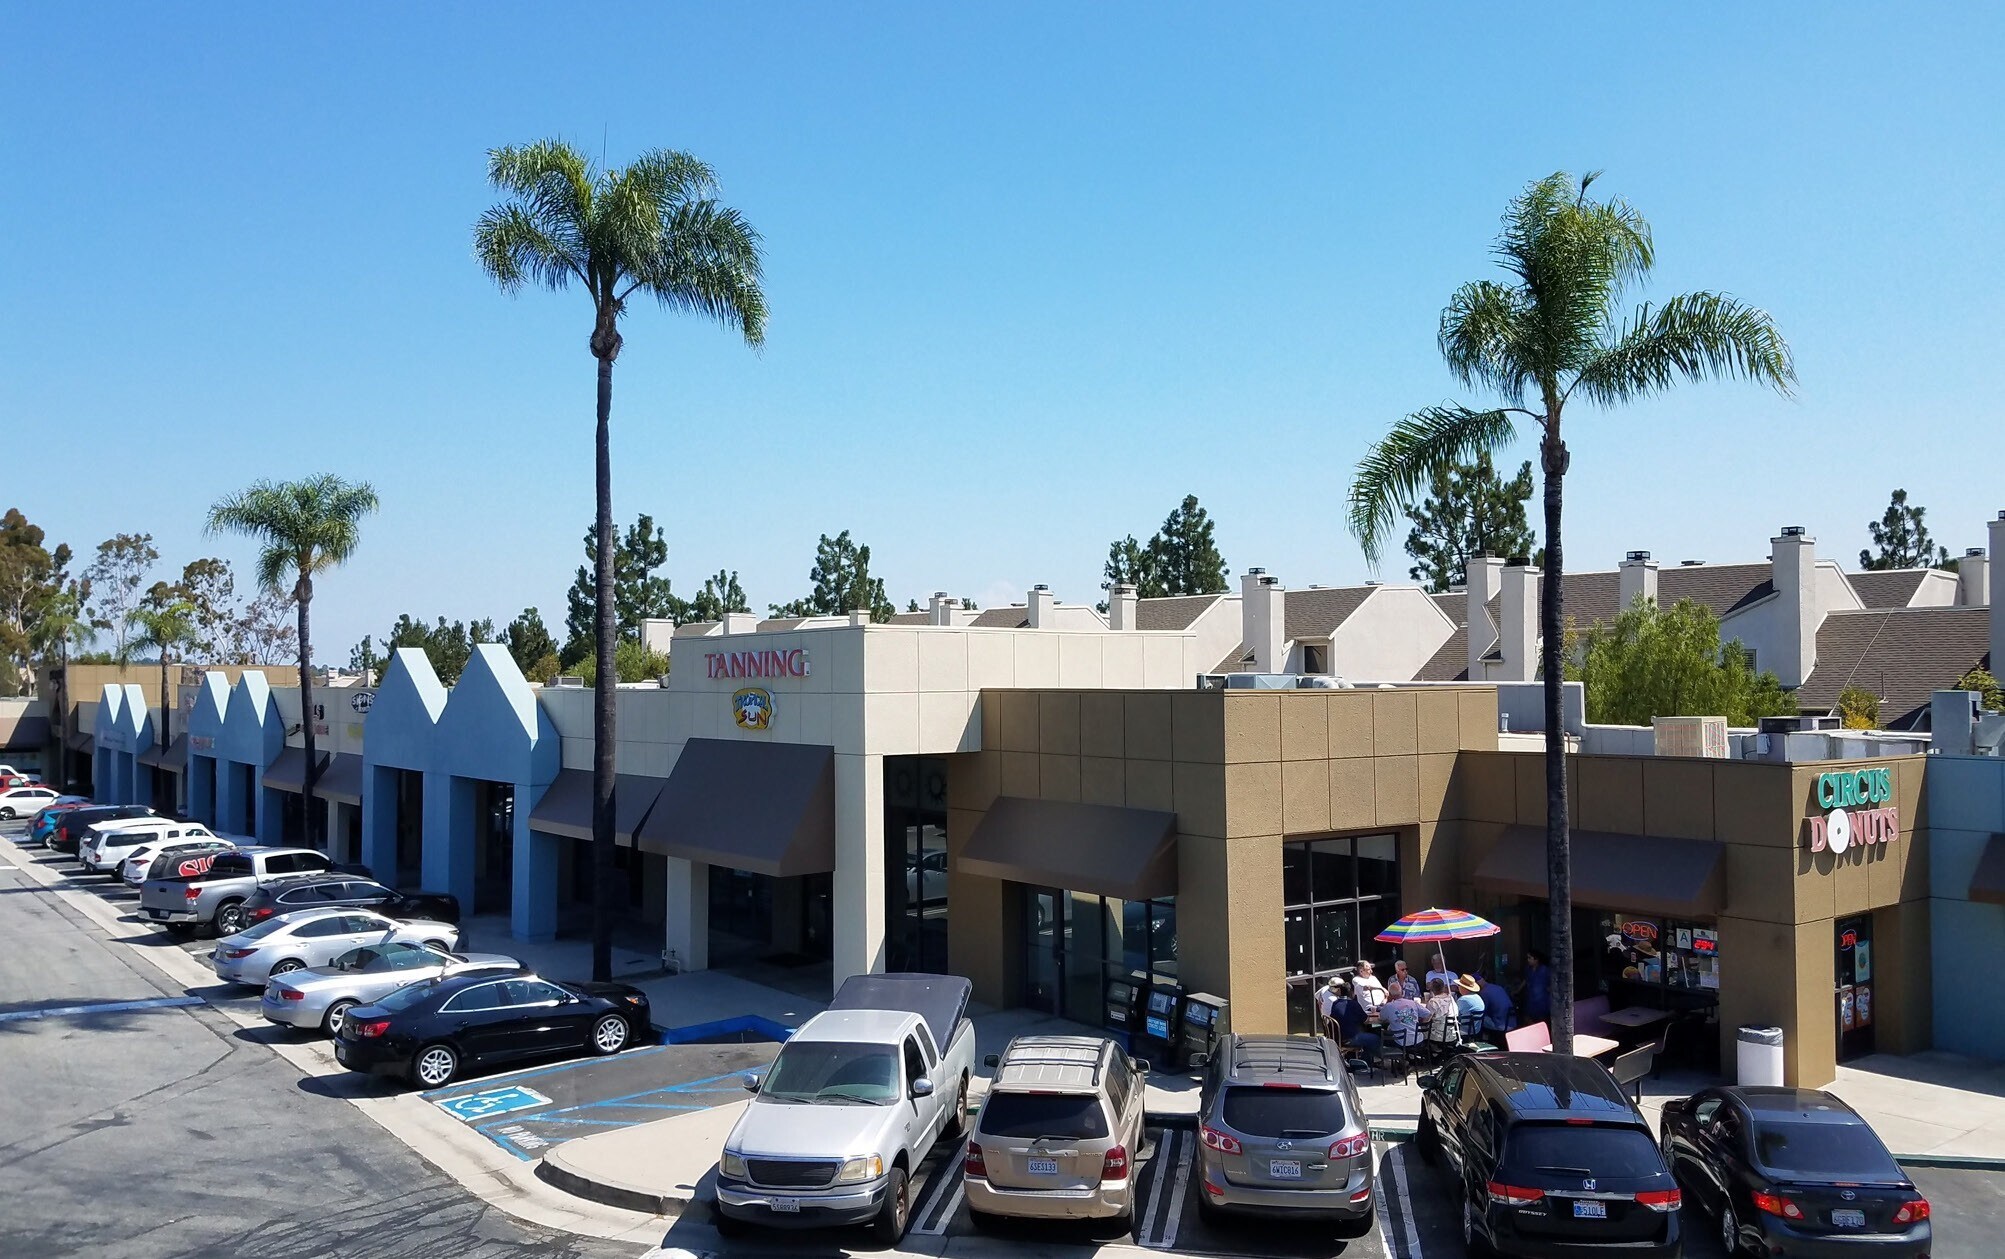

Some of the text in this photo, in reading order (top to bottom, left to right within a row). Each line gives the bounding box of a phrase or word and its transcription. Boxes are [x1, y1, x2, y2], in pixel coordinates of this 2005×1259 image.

[704, 649, 811, 678] TANNING
[738, 709, 767, 726] SUN
[1817, 767, 1891, 809] CIRCUS
[1811, 807, 1899, 854] DONUTS
[1622, 922, 1657, 939] OPEN
[1680, 932, 1688, 942] A
[1518, 1209, 1547, 1217] ODYSSEY
